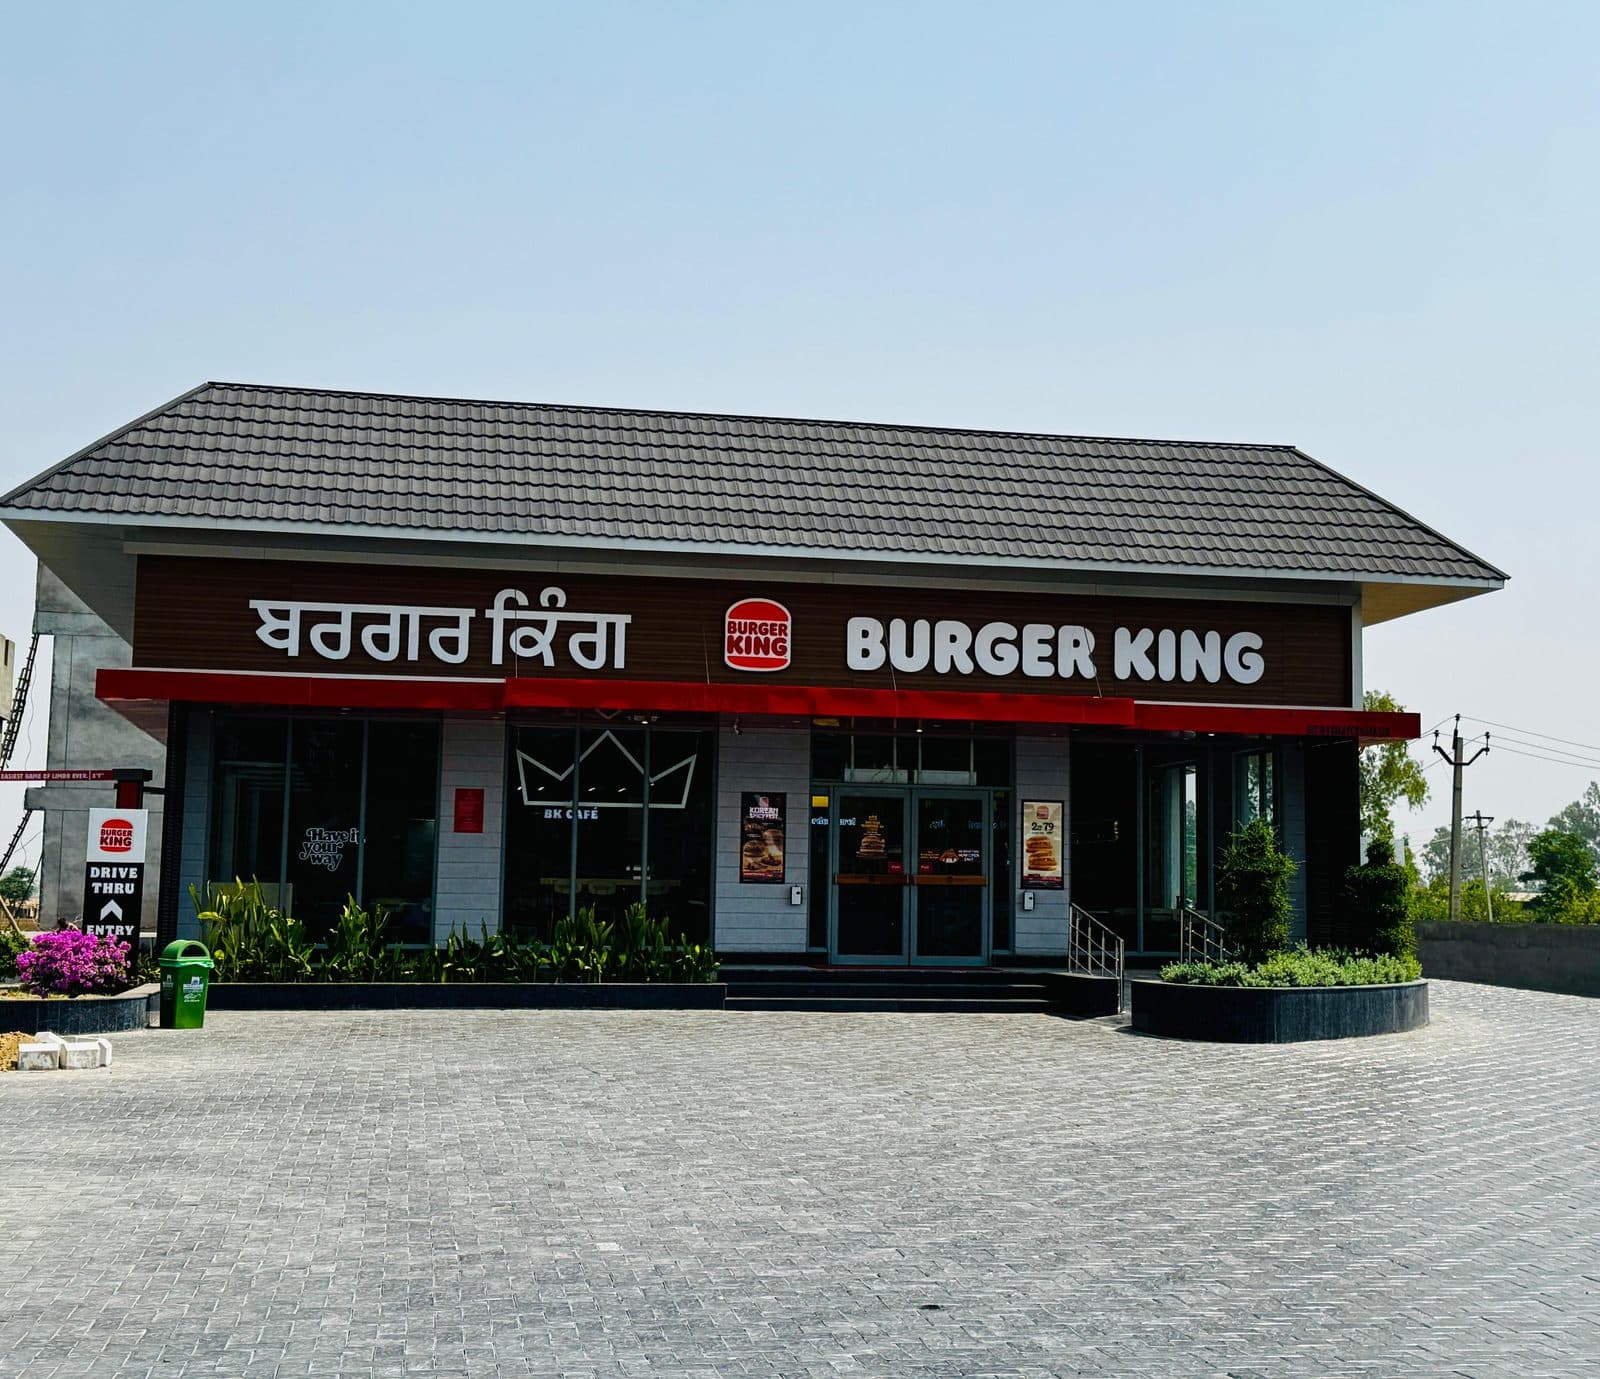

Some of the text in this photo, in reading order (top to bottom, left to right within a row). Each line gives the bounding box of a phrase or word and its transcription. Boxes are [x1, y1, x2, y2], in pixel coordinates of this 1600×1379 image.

[249, 586, 632, 669] ਬਰਗਰ ਕਿੰਗ
[727, 620, 788, 636] BURGER
[727, 635, 788, 656] KING
[847, 616, 1265, 684] BURGER KING
[544, 807, 599, 820] BK CAFÉ
[100, 828, 132, 836] BURGER
[306, 827, 349, 843] Have
[99, 836, 132, 847] KING
[299, 841, 344, 860] your
[310, 853, 343, 872] way
[90, 866, 138, 879] DRIVE
[91, 882, 135, 895] THRU
[86, 924, 135, 936] ENTRY
